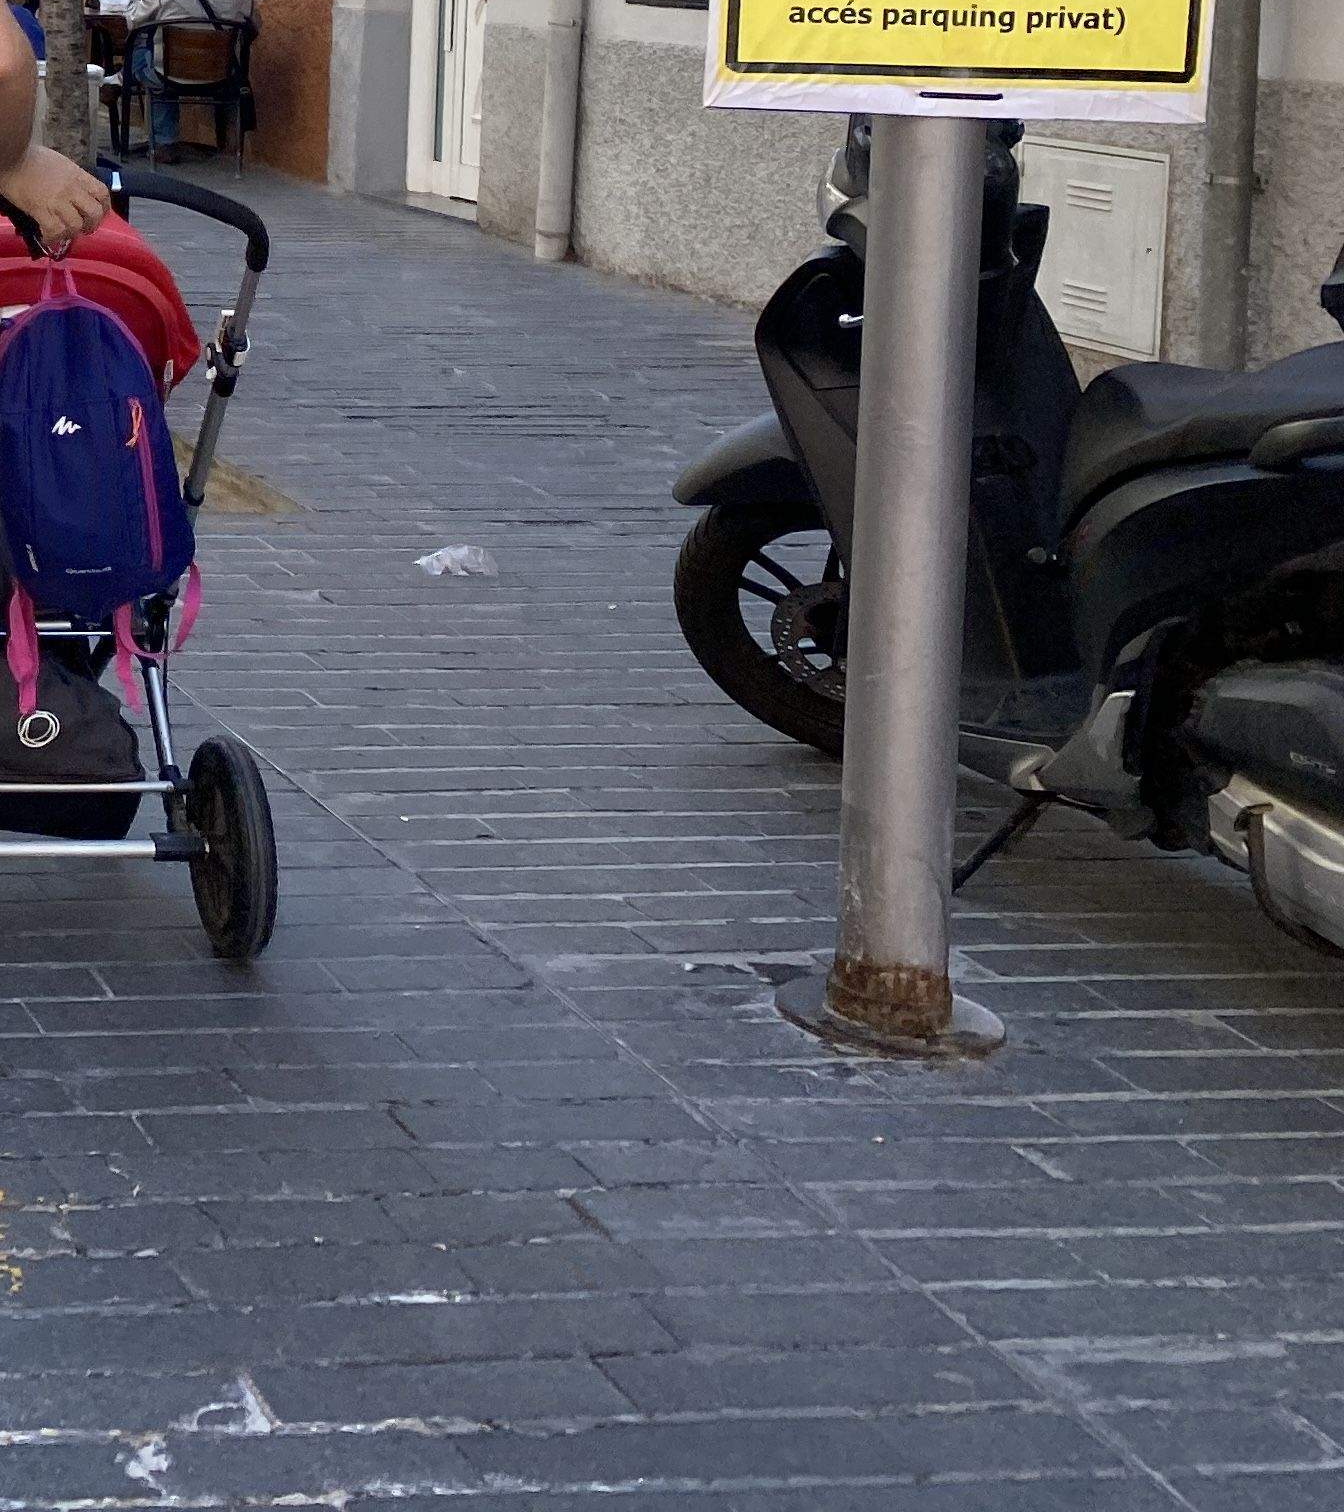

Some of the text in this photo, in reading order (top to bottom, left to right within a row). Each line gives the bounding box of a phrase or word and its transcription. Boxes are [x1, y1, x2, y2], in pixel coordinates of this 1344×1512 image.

[789, 0, 1125, 36] accés parquing privat)
